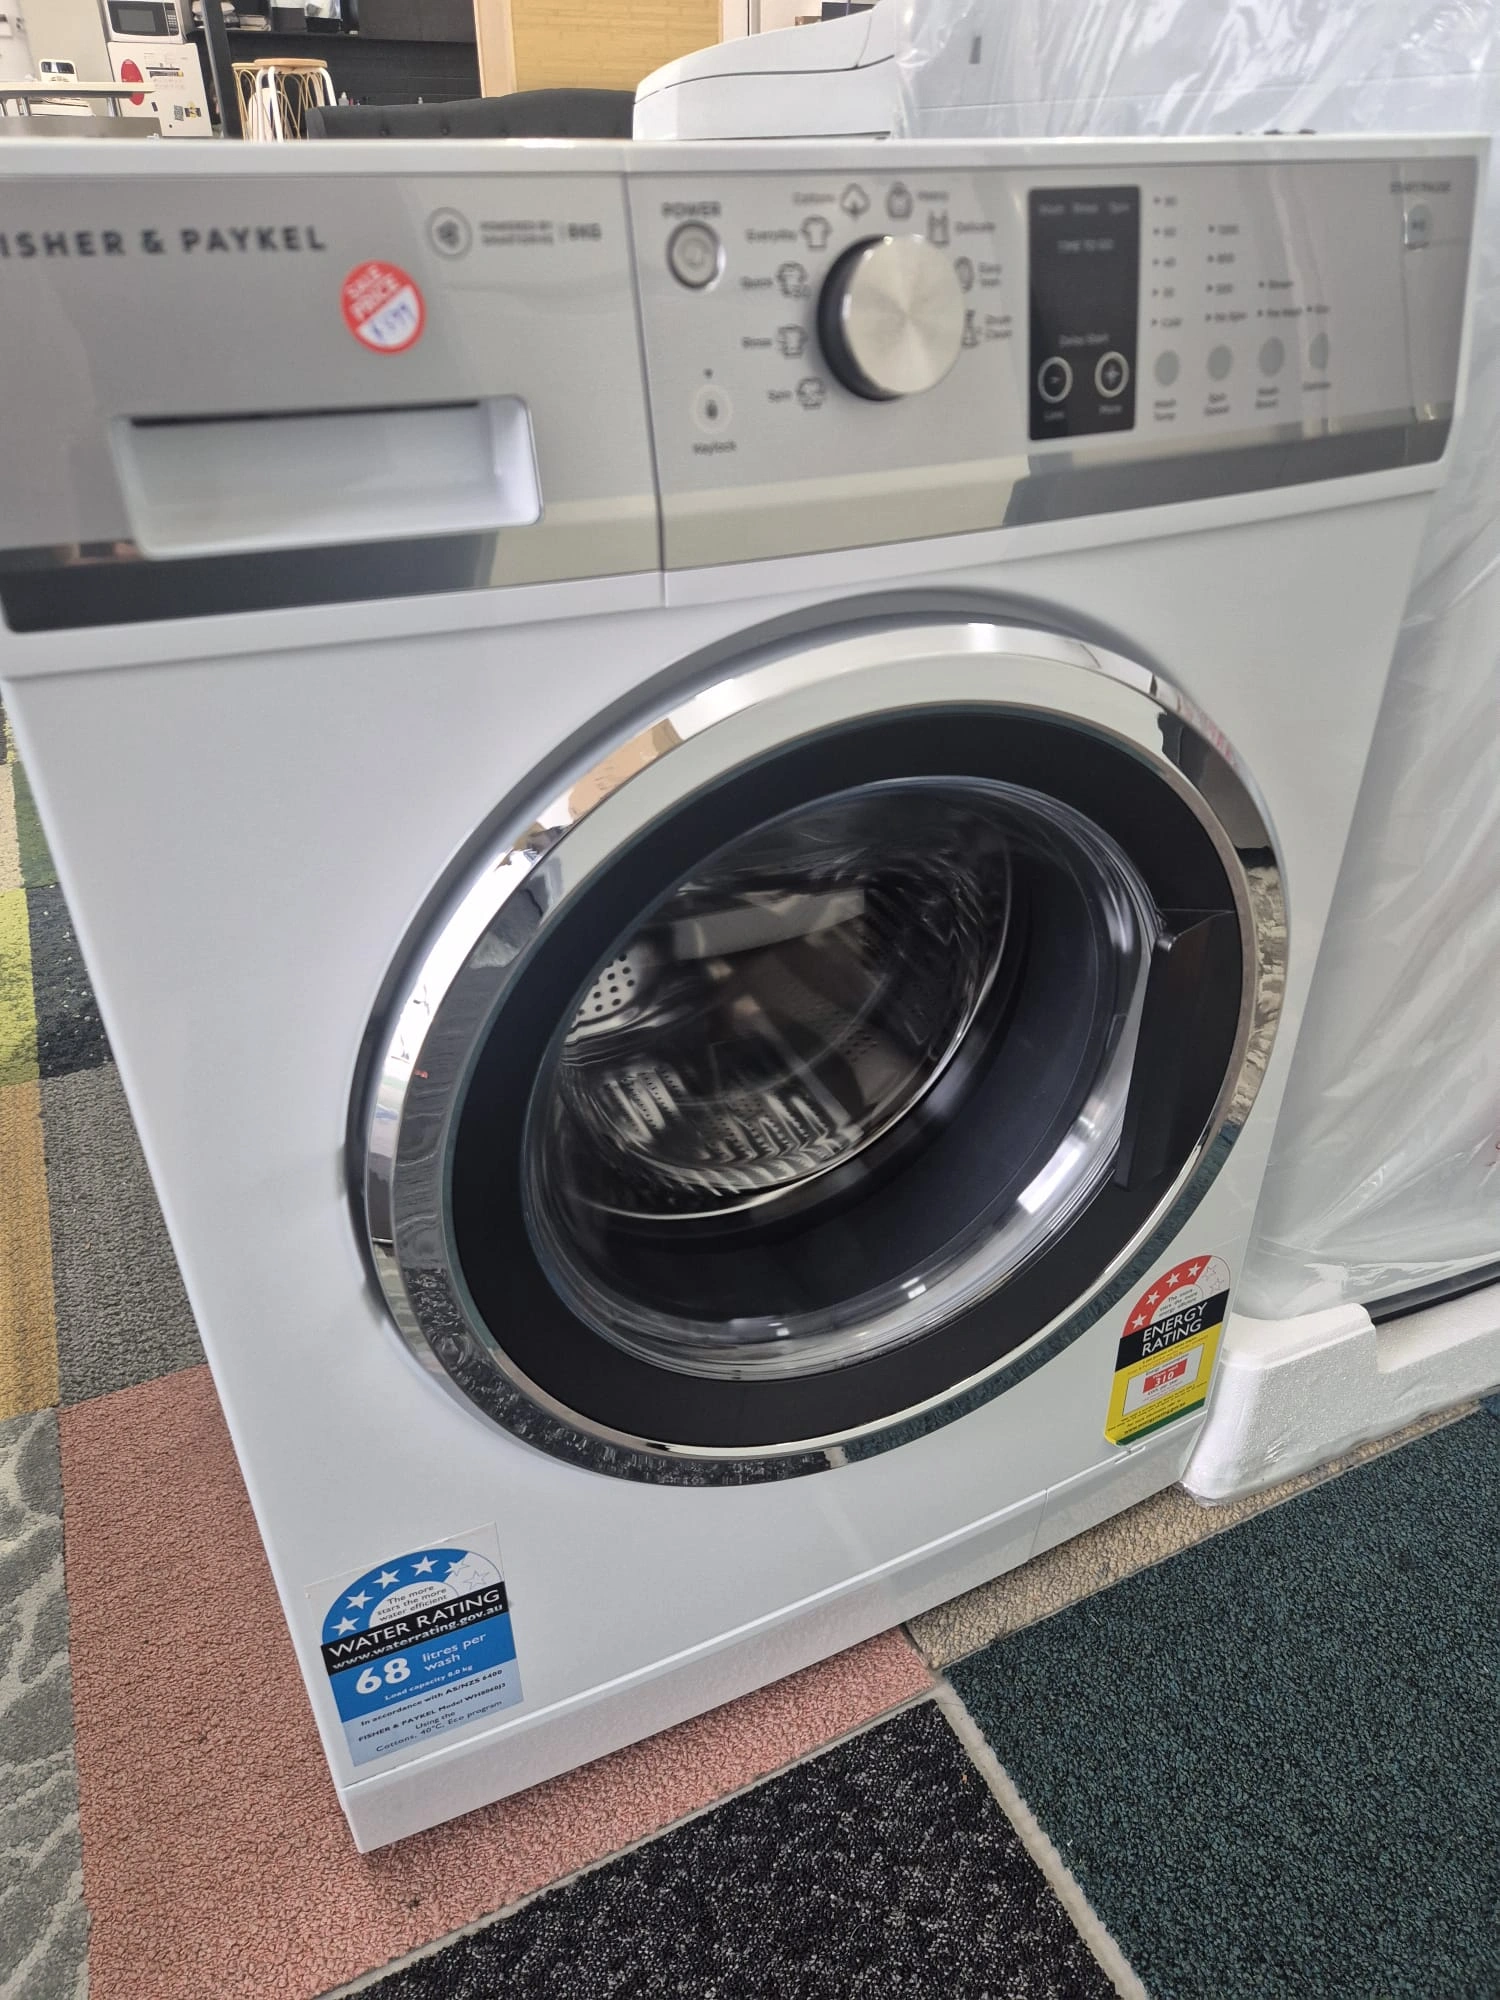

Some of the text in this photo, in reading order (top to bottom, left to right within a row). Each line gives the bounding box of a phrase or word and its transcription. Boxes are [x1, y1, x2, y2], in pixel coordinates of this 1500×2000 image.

[142, 229, 164, 255] &
[181, 226, 325, 252] PAYKEL
[1143, 1302, 1208, 1342] ENERGY
[1141, 1319, 1201, 1357] RATING
[1154, 1371, 1175, 1387] 310
[377, 1587, 447, 1616] stars the more
[378, 1594, 448, 1623] water efficient
[387, 1585, 435, 1605] The more
[329, 1588, 501, 1658] WATER RATING
[332, 1603, 504, 1671] www.waterrating.gov.au
[421, 1632, 487, 1664] litres per
[424, 1652, 461, 1672] wash
[355, 1657, 412, 1695] 68
[408, 1675, 447, 1693] capacity
[361, 1718, 370, 1727] In
[371, 1701, 423, 1723] accordance
[424, 1692, 445, 1703] with
[445, 1677, 481, 1696] AS/NZS
[415, 1711, 456, 1731] Using the
